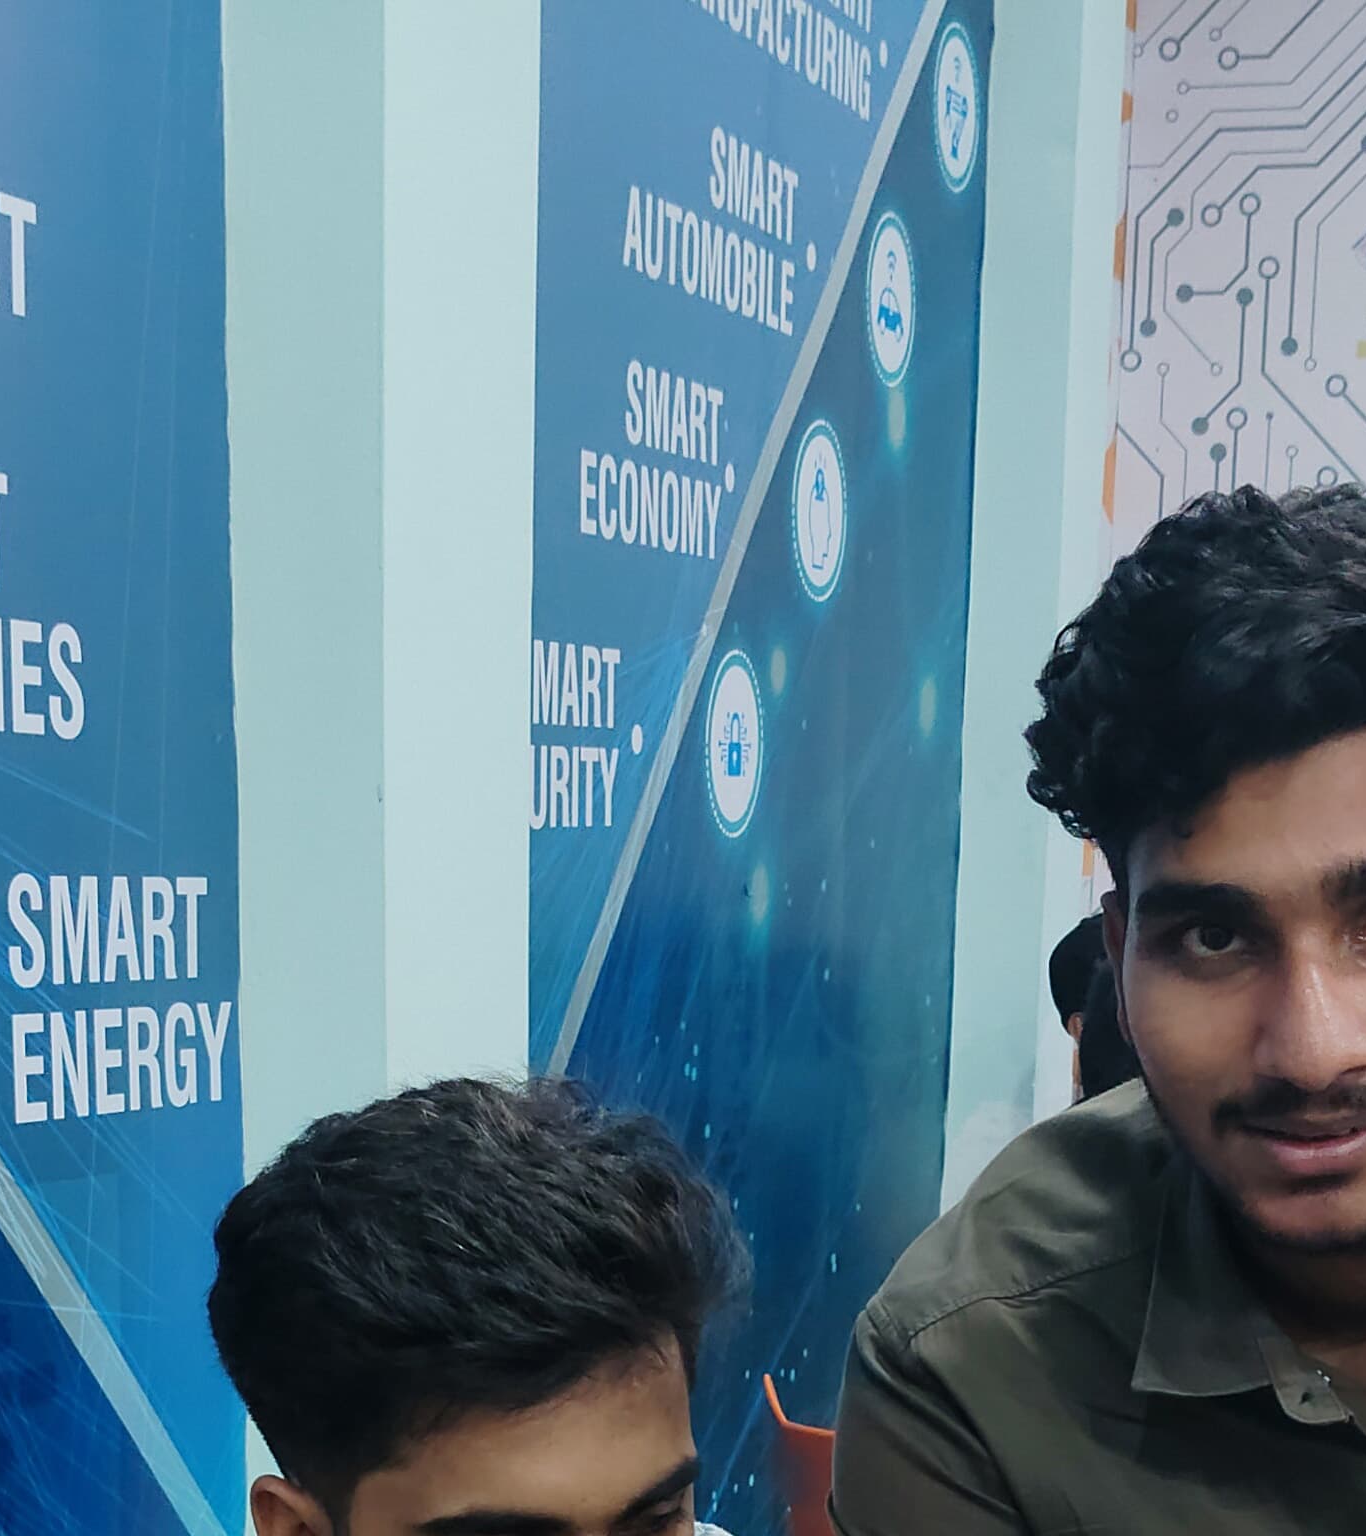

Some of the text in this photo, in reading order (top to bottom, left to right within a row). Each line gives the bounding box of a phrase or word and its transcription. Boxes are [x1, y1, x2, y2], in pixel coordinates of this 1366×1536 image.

[709, 125, 798, 245] SMART
[622, 185, 798, 336] AUTOMOBILE
[625, 359, 723, 465] SMART
[580, 450, 722, 560] ECONOMY
[7, 873, 207, 988] SMART
[12, 1001, 232, 1123] ENERGY
